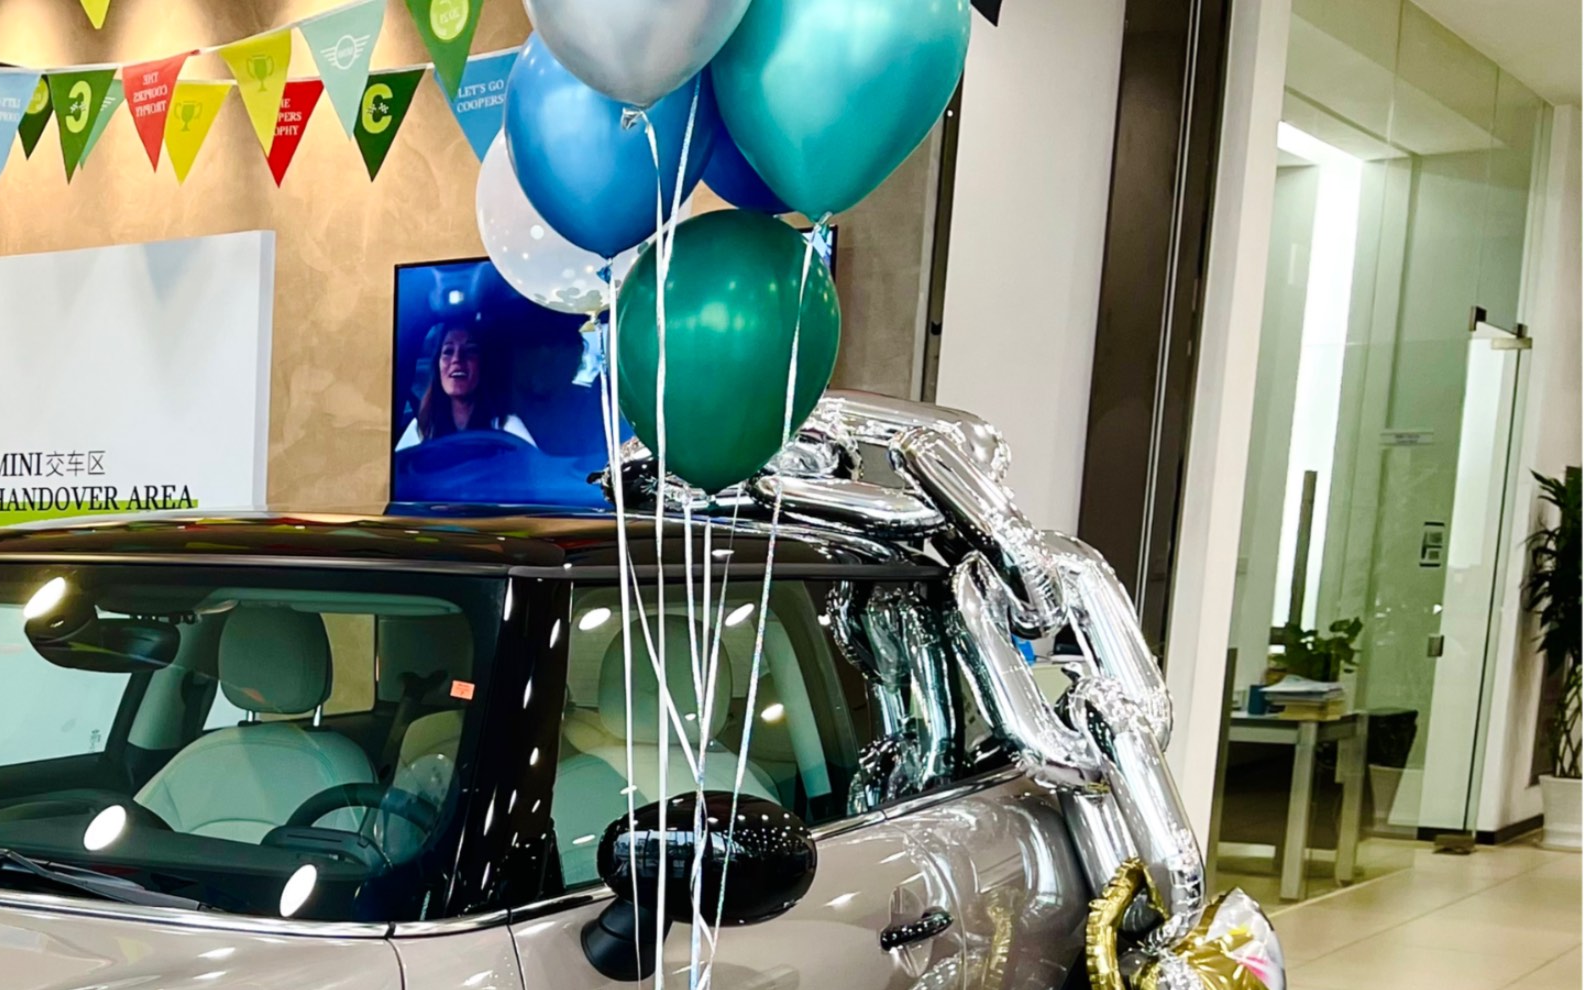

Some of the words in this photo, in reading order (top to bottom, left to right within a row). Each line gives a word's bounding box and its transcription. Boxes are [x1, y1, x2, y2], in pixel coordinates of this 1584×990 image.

[458, 83, 486, 99] LET'S
[488, 79, 504, 92] GO
[457, 94, 505, 113] COOPERS
[278, 111, 302, 123] PERS
[126, 484, 194, 510] AREA
